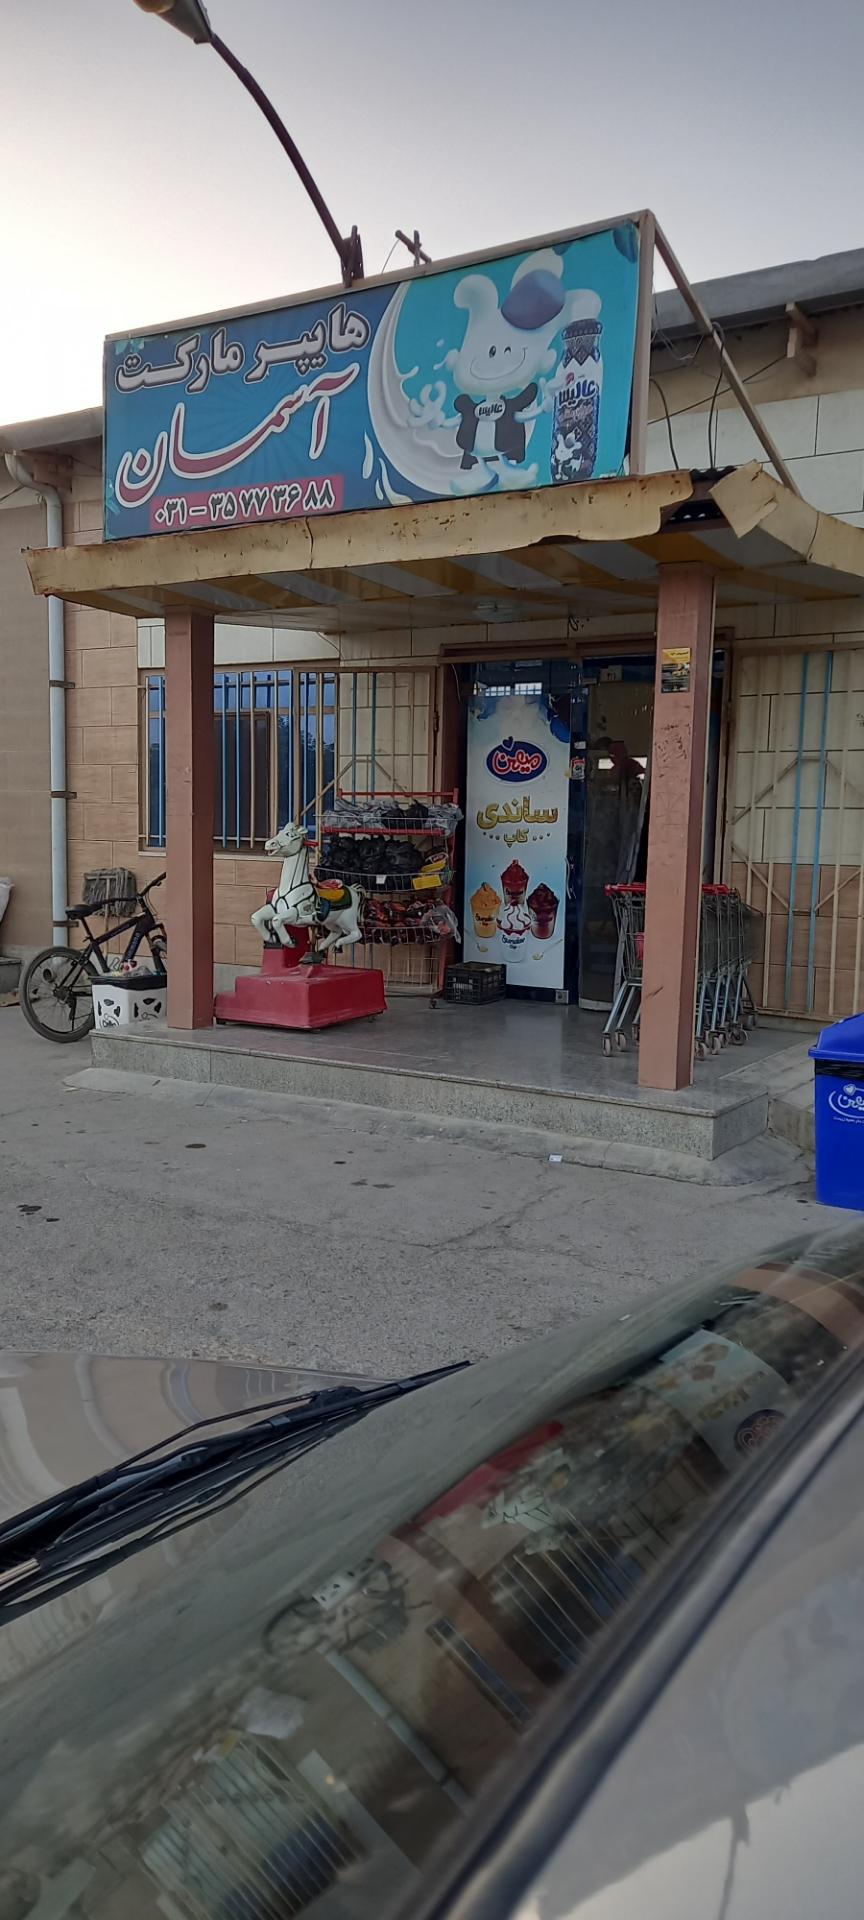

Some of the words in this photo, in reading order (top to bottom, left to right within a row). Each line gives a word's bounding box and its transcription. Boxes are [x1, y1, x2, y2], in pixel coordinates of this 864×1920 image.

[115, 327, 245, 394] مارکت
[244, 302, 371, 384] هایپر
[115, 363, 360, 508] آسمان
[476, 795, 559, 831] ساندی
[504, 828, 530, 848] کاپ
